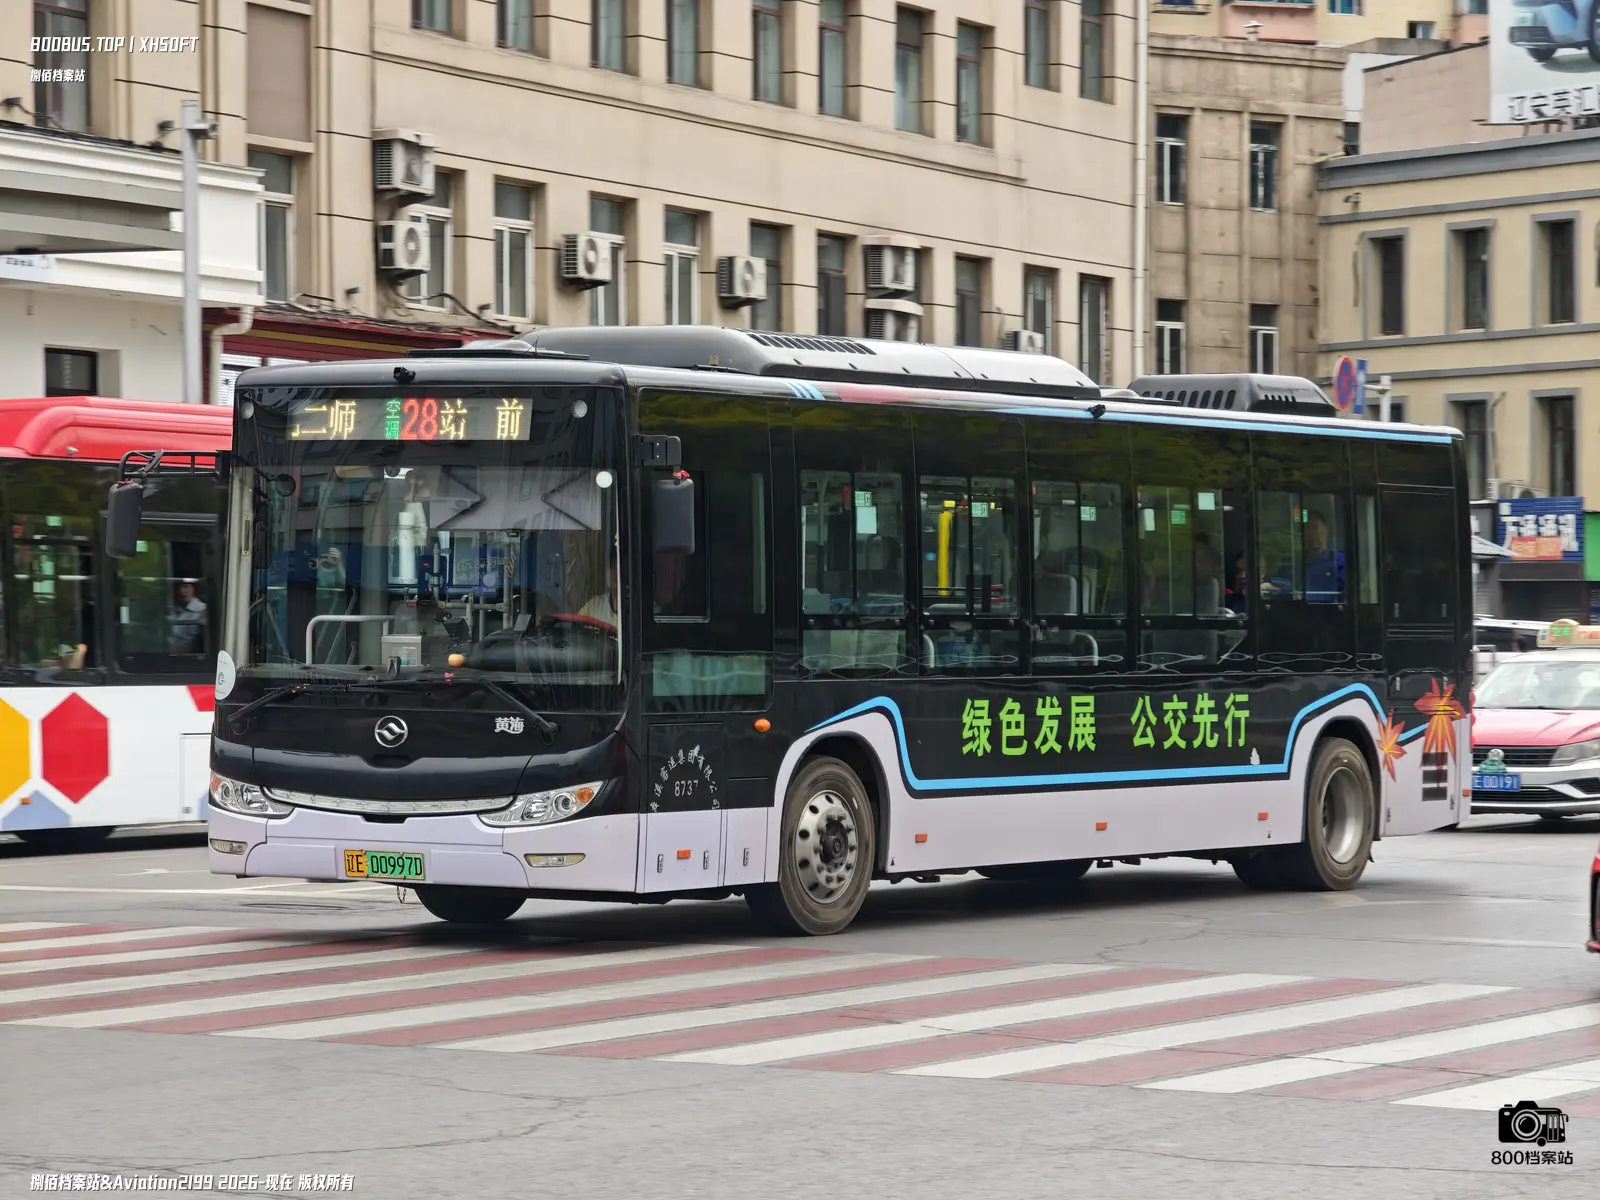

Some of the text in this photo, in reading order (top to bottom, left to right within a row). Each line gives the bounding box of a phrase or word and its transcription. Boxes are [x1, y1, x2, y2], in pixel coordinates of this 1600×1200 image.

[401, 399, 438, 440] 28
[494, 716, 525, 734] 黄海
[961, 692, 1250, 757] 绿色发展 公交先行
[346, 854, 423, 876] 辽E 00997D
